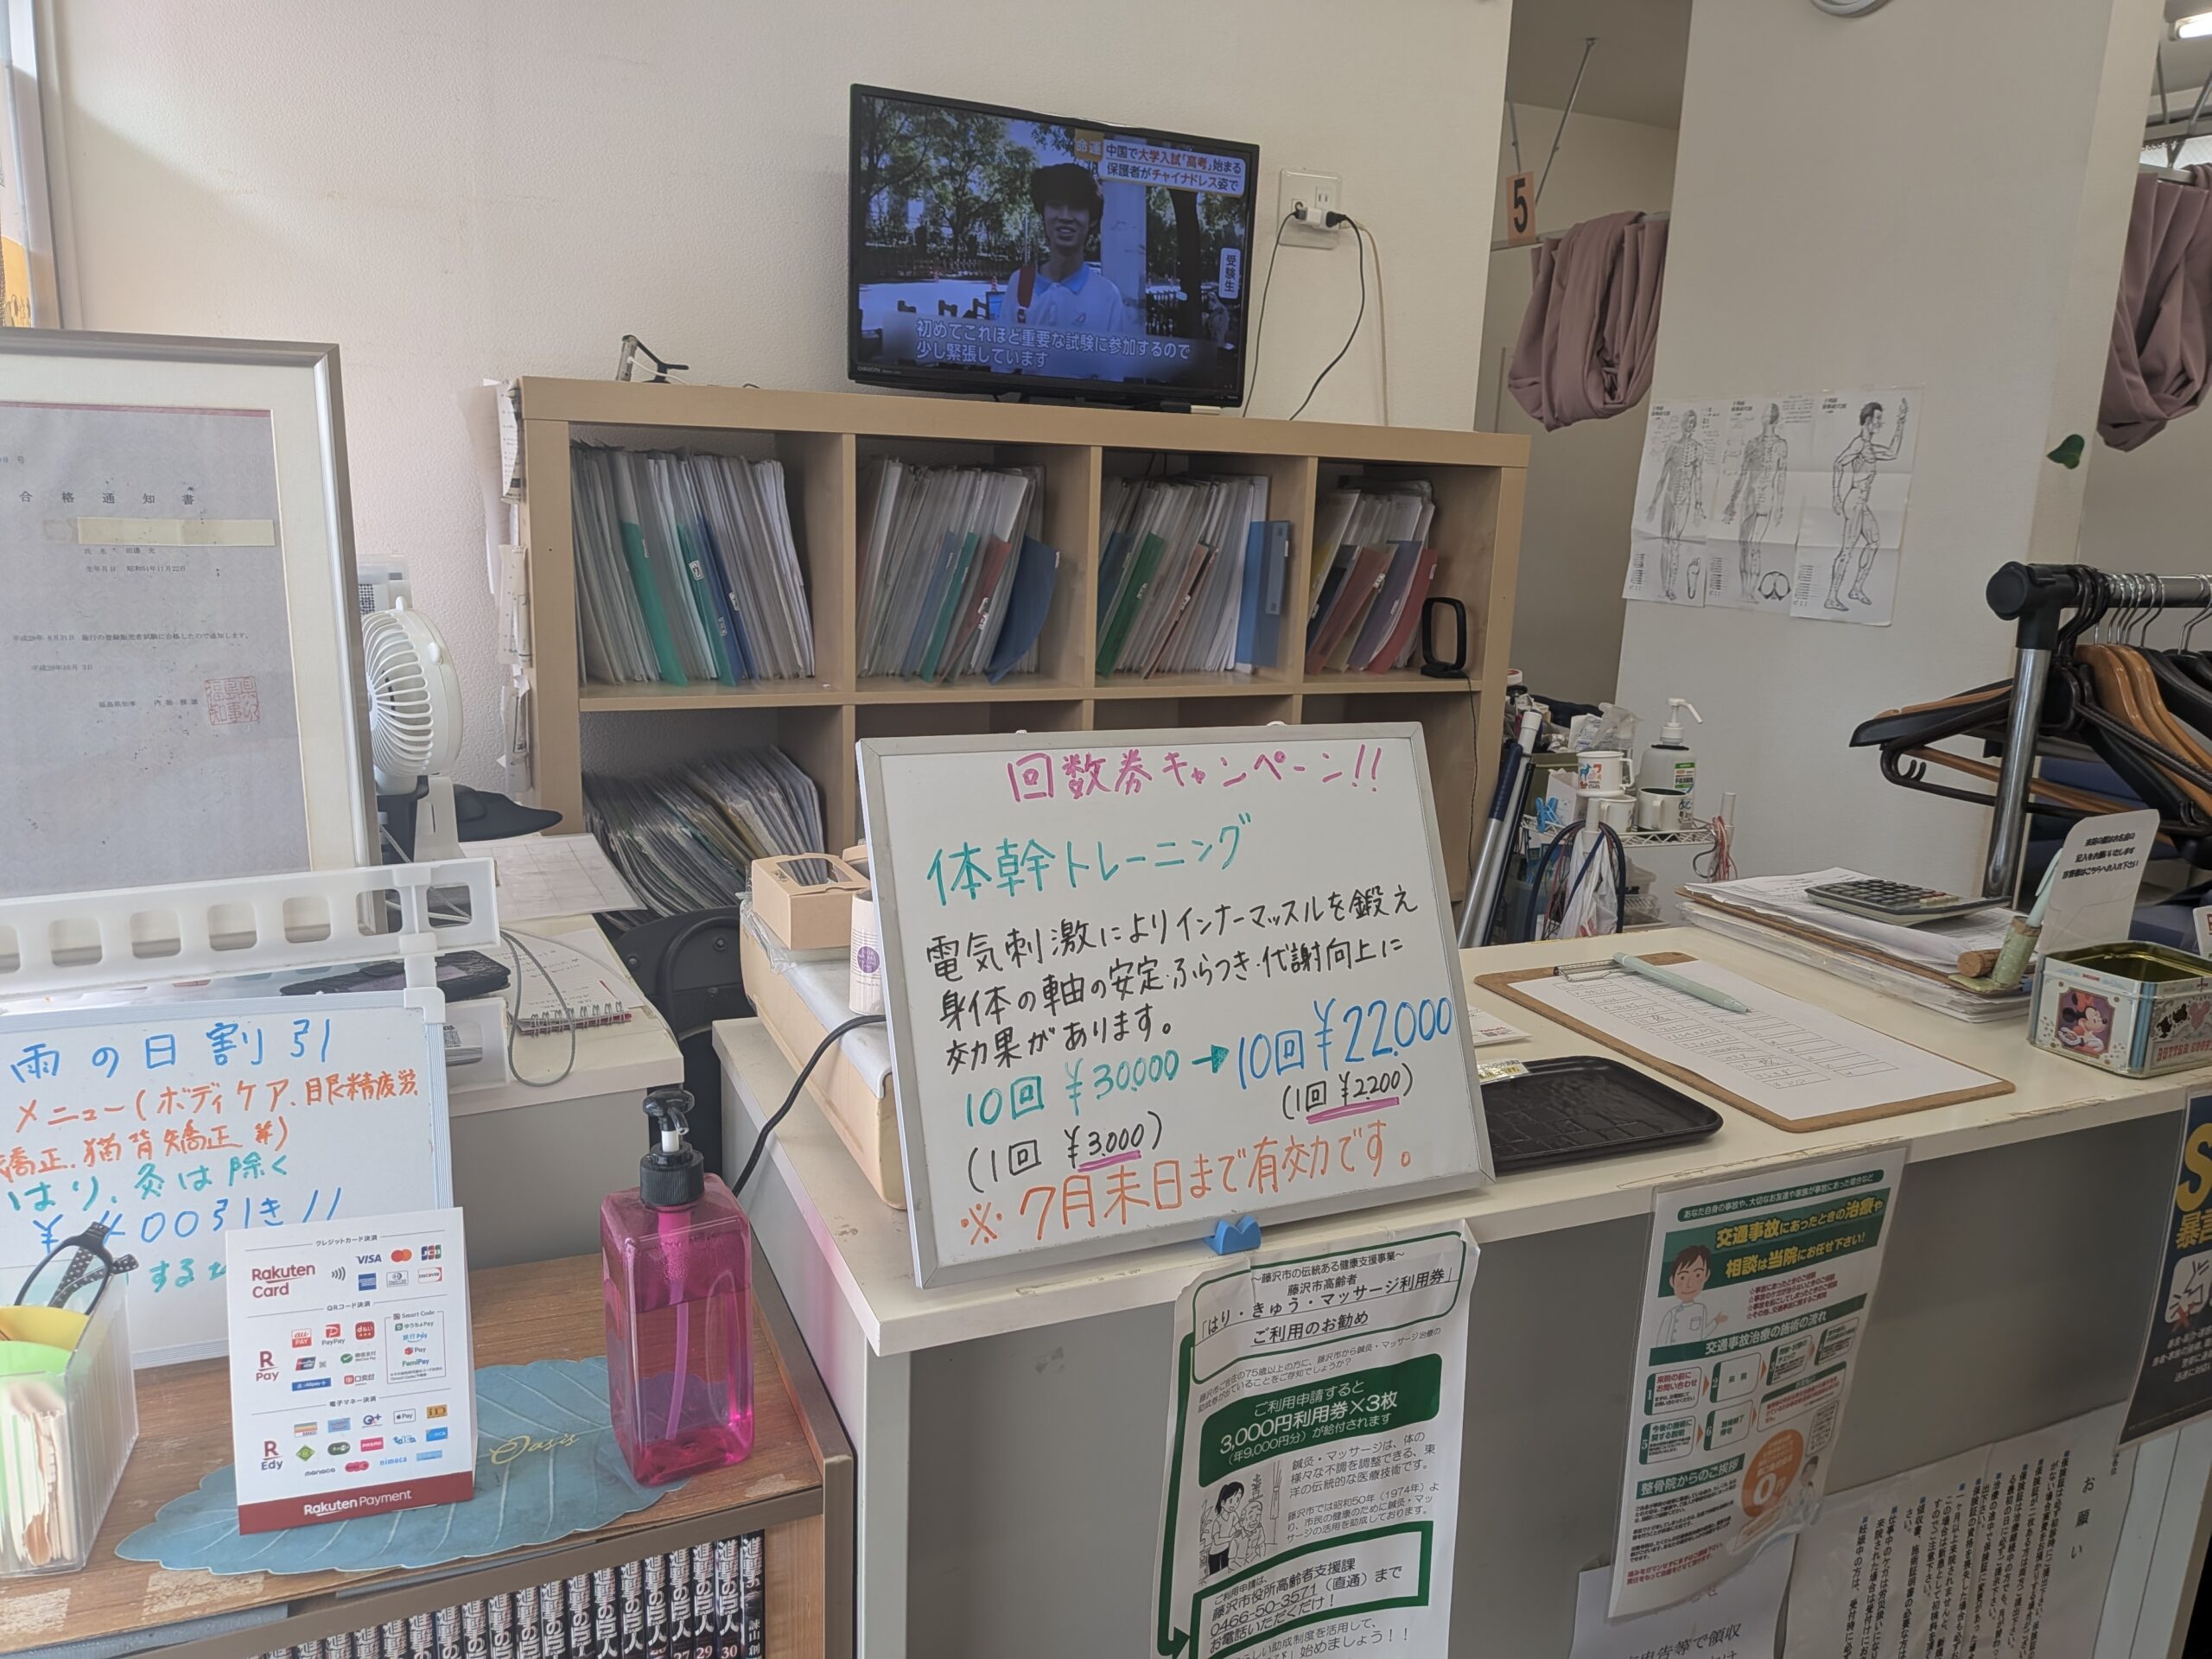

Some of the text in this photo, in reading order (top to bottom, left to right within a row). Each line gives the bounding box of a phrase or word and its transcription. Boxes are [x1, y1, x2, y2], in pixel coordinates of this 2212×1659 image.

[1106, 144, 1242, 175] 中国で大学入試「高考」始まる
[1107, 162, 1239, 192] 保護者がチャイナドレス姿で
[1513, 177, 1528, 233] 5
[1224, 254, 1237, 293] 受験生
[916, 318, 1191, 360] 初めてこれほど重要な試験に参加するので
[916, 341, 1048, 368] 少し緊張しています
[1007, 743, 1382, 803] 回数券キャンペーン!!
[926, 813, 1251, 906] 体幹トレーニング
[926, 884, 1418, 982] 電気刺激によりインナーマッスルを鍛え
[10, 1019, 331, 1084] 雨の日割引
[945, 1003, 1172, 1076] 効果があります。
[1238, 1030, 1305, 1090] 10回
[966, 1076, 1045, 1127] 10回
[315, 1234, 378, 1248] クレジットカード決済
[1715, 1196, 1884, 1249] 交通事故にあったときの治療や
[251, 1244, 442, 1282] Rakuten VISA JCB
[252, 1283, 289, 1299] Card
[1201, 1267, 1454, 1340] 「はり・きゅう・マッサージ利用券」
[1287, 1274, 1358, 1297] 藤沢市高齢者
[327, 1300, 371, 1312] QRコード決済
[402, 1309, 435, 1319] Smart Code
[321, 1338, 346, 1347] PayPay
[1253, 1311, 1369, 1344] ご利用のお勧め
[1705, 1311, 1827, 1356] 交通事故治療の施術の流れ
[256, 1370, 279, 1382] Pay
[402, 1358, 429, 1368] FamiPay
[1254, 1380, 1365, 1418] ご利用申請すると
[1647, 1389, 1652, 1400] 1
[1712, 1377, 1718, 1389] 2
[489, 1433, 581, 1465] Oasis
[1641, 1440, 1648, 1450] 5
[1706, 1426, 1712, 1437] 6
[261, 1459, 283, 1471] Edy
[380, 1456, 408, 1466] nimoca
[1288, 1458, 1430, 1498] 洋の伝統的な医療技術です。
[1291, 1443, 1436, 1484] 様々な不調を調整できる、東
[1641, 1459, 1739, 1496] 整骨院からのご挨拶
[304, 1489, 413, 1516] Rakuten Payment
[2071, 1476, 2096, 1560] お願い
[1286, 1505, 1429, 1544] サージの活用を助成しております。
[645, 1554, 668, 1647] 進撃の巨人
[670, 1548, 692, 1642] 進撃の巨人
[693, 1541, 715, 1637] 進撃の巨人
[718, 1537, 740, 1637] 進撃の巨人
[1211, 1557, 1356, 1622] 藤沢市役所高齢者支援課
[1214, 1574, 1268, 1605] ご利用申請は、
[594, 1567, 619, 1659] 進撃の巨人
[621, 1560, 645, 1655] 進撃の巨人
[696, 1646, 713, 1658] 29
[721, 1645, 738, 1659] 30
[1629, 1622, 1742, 1659] 申告等で領収
